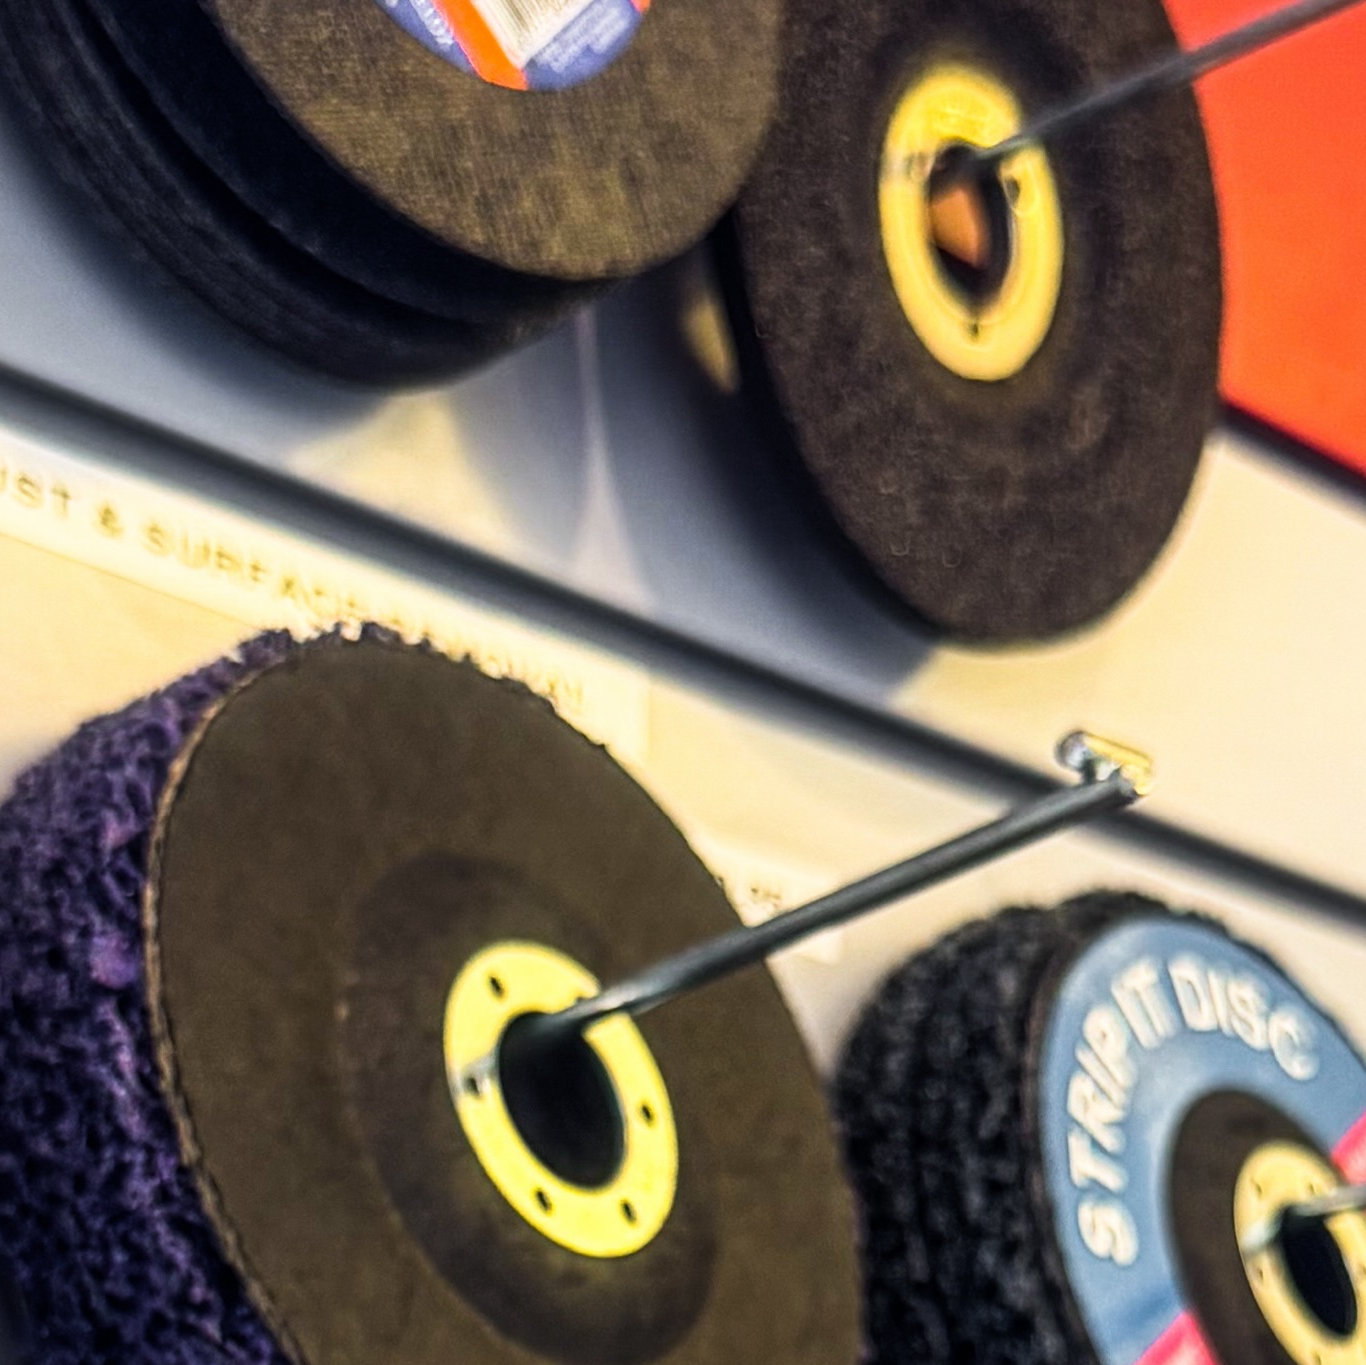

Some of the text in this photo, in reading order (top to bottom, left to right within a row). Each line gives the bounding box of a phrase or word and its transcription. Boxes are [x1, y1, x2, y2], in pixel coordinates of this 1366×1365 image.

[1068, 955, 1321, 1267] STRIP IT DISC
